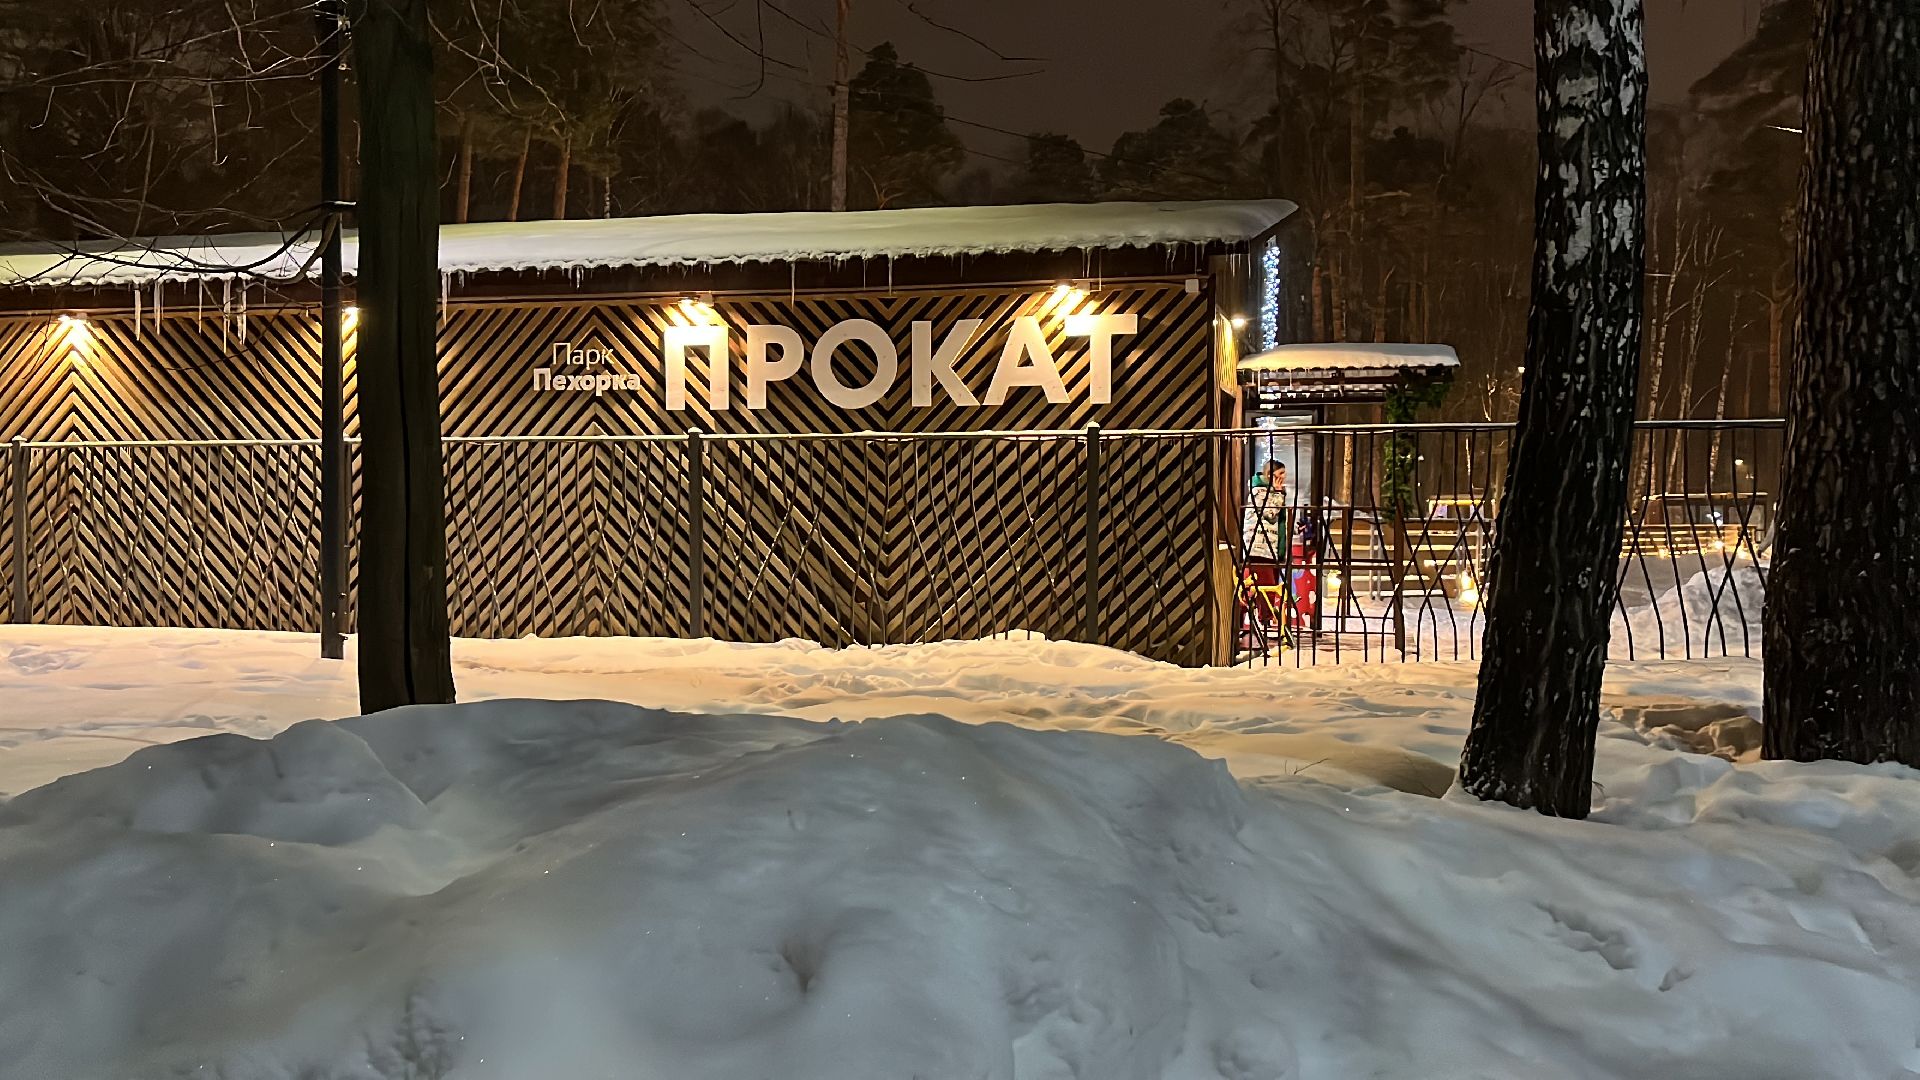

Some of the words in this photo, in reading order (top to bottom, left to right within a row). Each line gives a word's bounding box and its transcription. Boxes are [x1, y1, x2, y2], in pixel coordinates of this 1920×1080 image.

[553, 342, 614, 370] Парк
[664, 314, 1138, 410] ПРОКАТ
[533, 367, 641, 396] Пехорка
